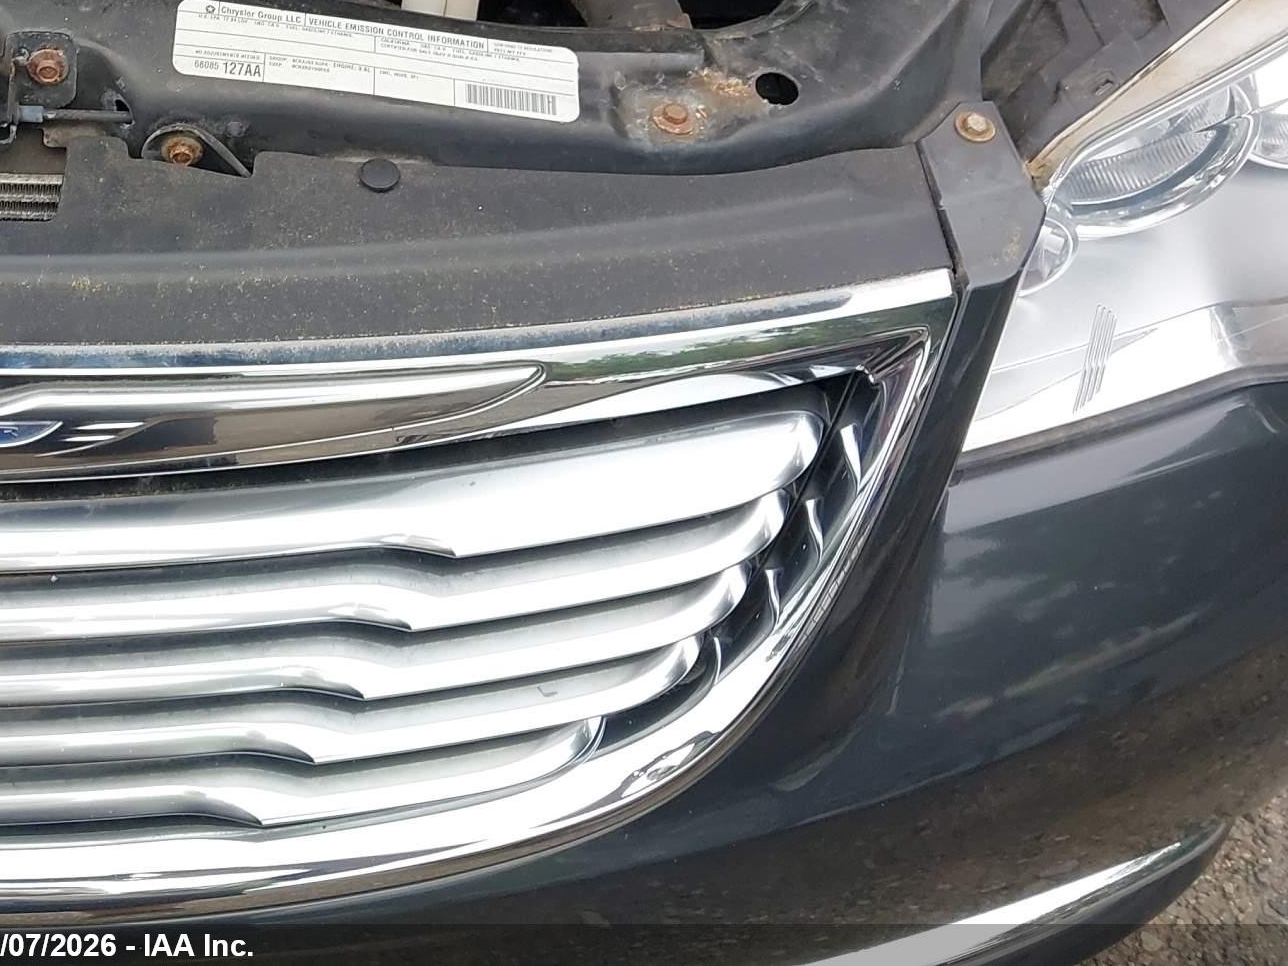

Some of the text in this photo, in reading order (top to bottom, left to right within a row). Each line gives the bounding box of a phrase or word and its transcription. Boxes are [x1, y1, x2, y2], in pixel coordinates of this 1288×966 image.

[221, 6, 255, 19] Chrysler
[257, 11, 283, 23] Group
[285, 15, 302, 24] LLC
[308, 17, 343, 30] VEHICLE
[345, 22, 385, 35] EMISSION
[386, 28, 425, 42] CONTROL
[427, 34, 485, 50] INFORMATION
[223, 61, 262, 78] 127AA
